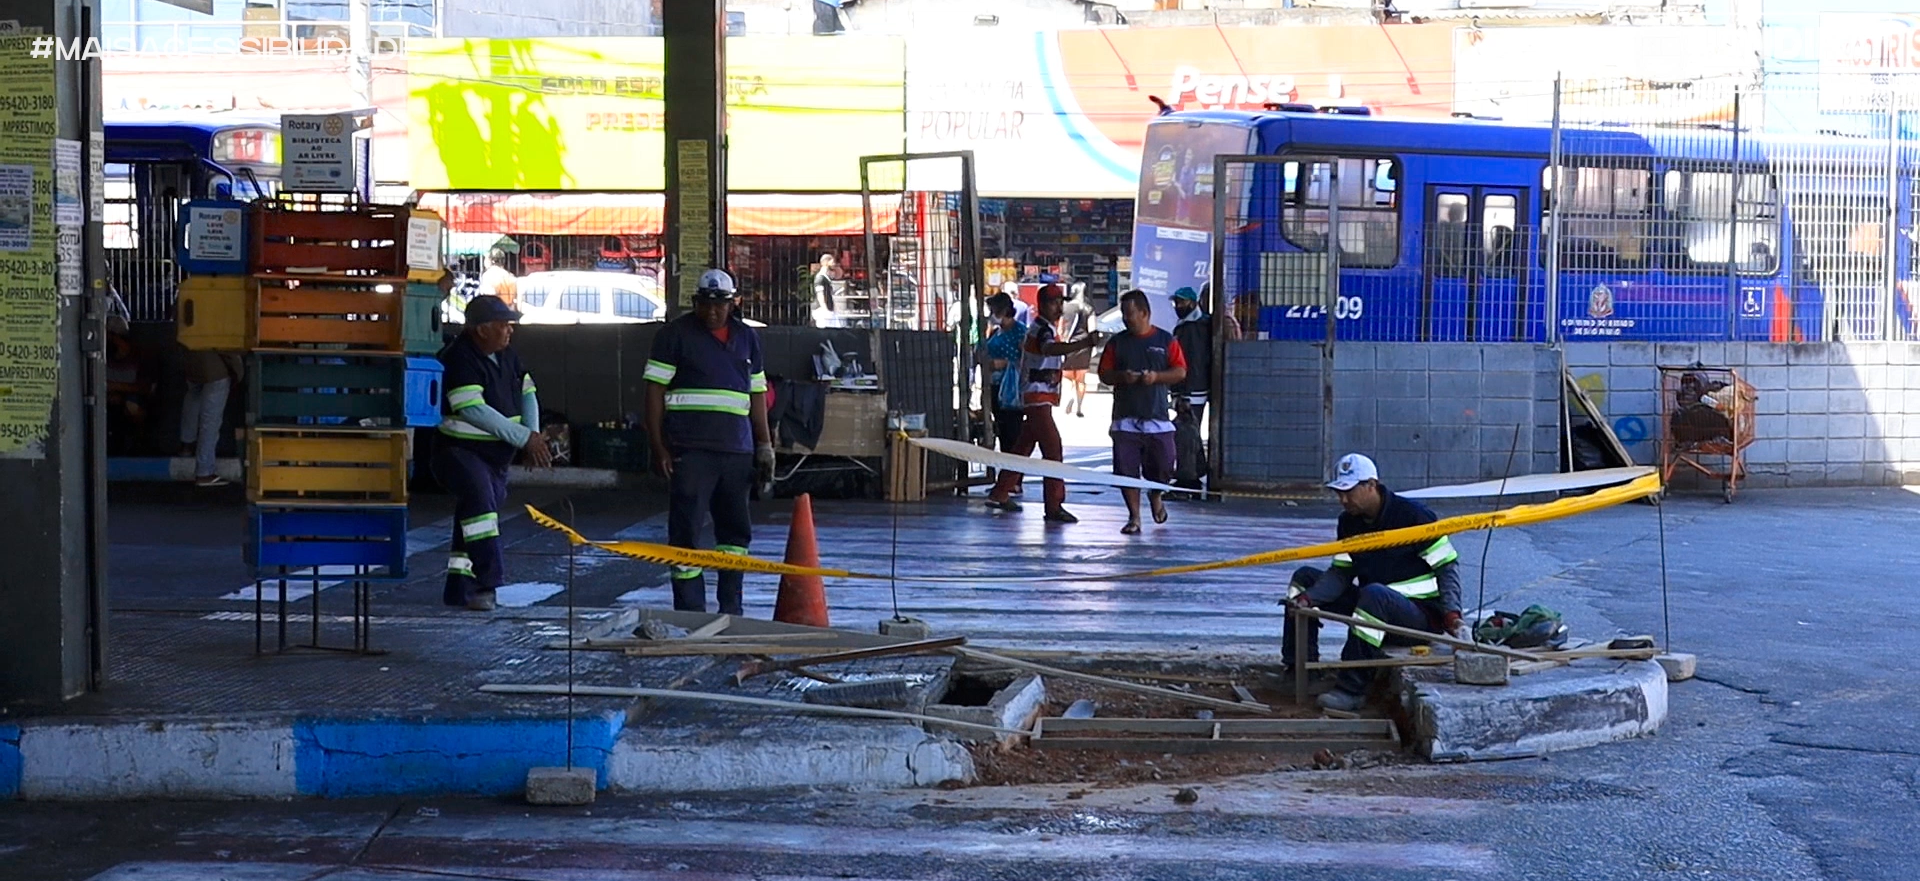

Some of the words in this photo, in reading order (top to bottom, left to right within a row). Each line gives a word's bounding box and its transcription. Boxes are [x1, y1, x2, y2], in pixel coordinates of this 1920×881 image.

[1168, 65, 1298, 110] Pense
[288, 119, 322, 132] Rotary
[920, 110, 1025, 140] POPULAR
[199, 211, 223, 221] Rotary
[676, 550, 688, 558] na
[690, 551, 733, 565] melhoria
[735, 559, 748, 568] do
[750, 560, 767, 569] seu
